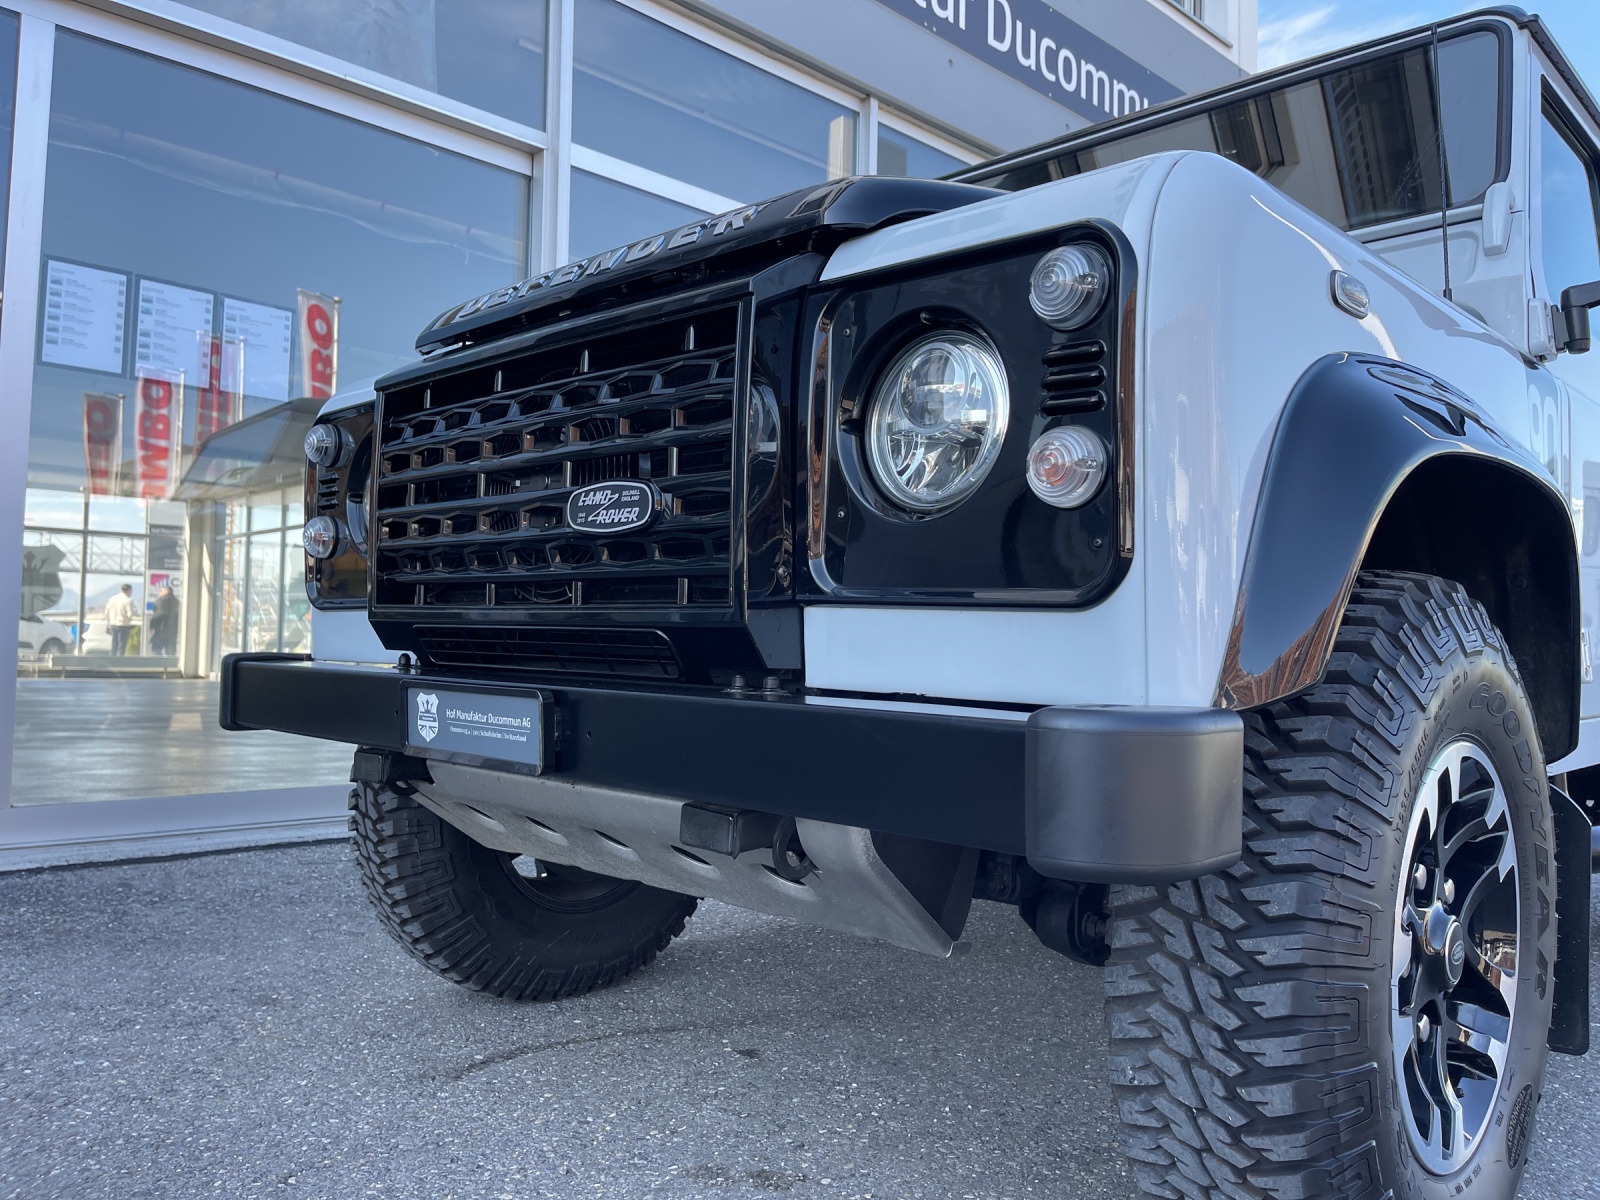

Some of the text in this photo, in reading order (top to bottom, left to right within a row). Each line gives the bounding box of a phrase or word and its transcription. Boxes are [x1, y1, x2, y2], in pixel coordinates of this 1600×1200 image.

[987, 0, 1149, 119] Ducomm
[455, 203, 770, 319] DEFENDER
[578, 490, 613, 506] LAND
[596, 507, 640, 524] ROVER
[446, 708, 456, 719] Hof
[456, 709, 488, 723] Manufaktur
[488, 713, 522, 727] Ducommun
[522, 717, 531, 728] AG
[1468, 681, 1550, 1001] GOODYEAR
